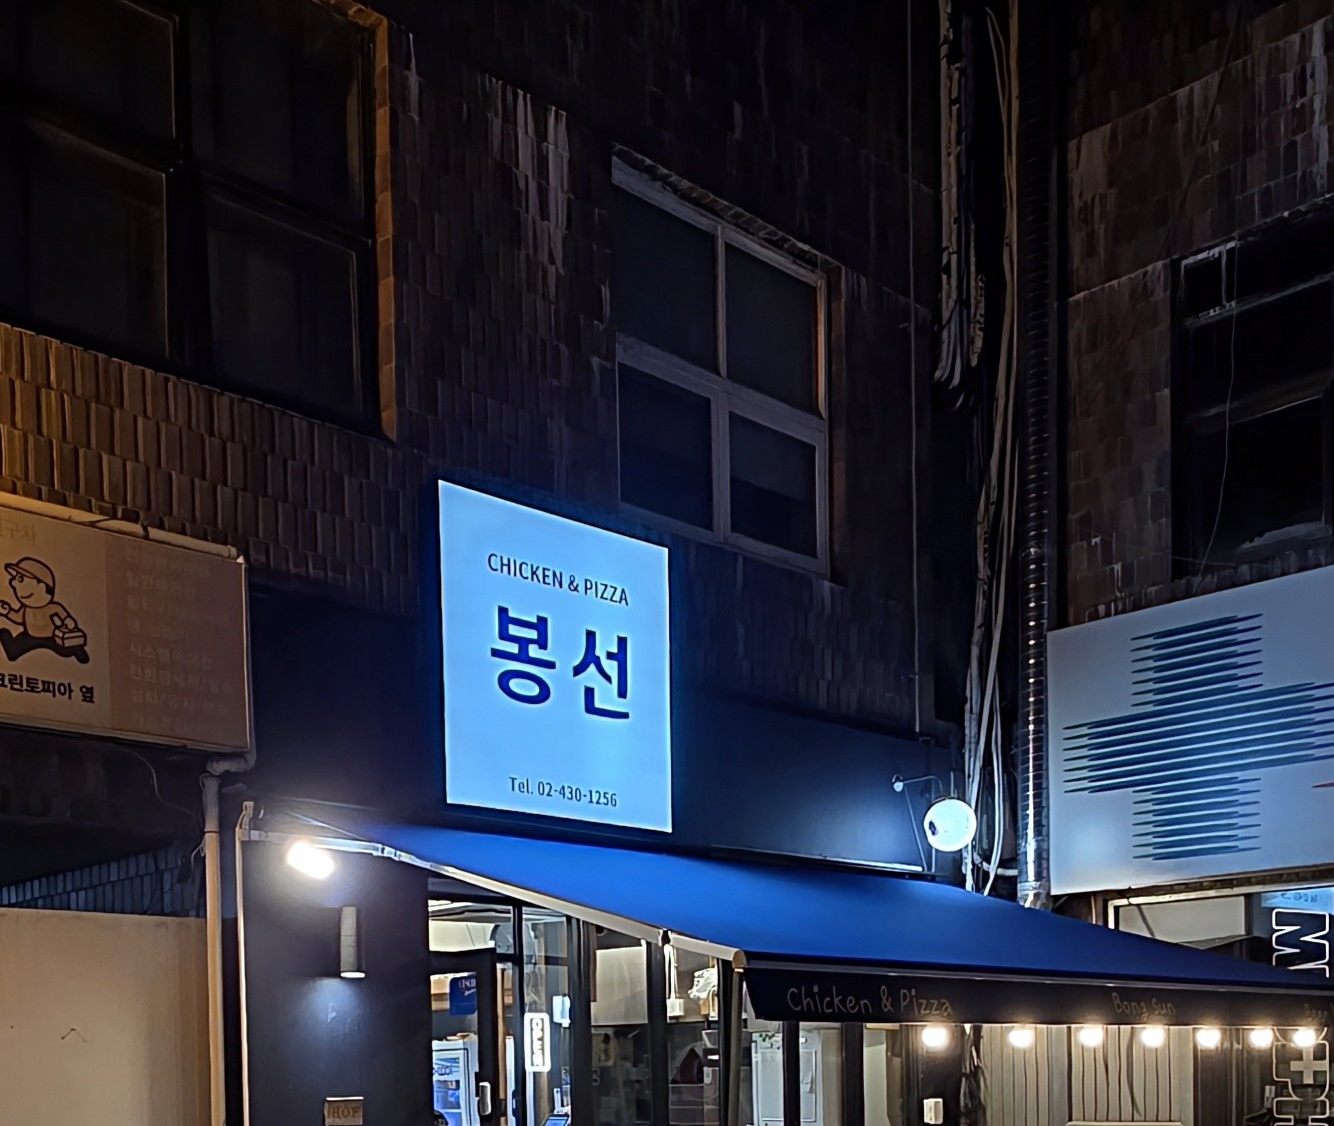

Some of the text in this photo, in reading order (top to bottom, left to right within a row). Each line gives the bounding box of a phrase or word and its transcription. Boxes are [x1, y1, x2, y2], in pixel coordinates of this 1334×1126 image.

[487, 552, 629, 607] CHICKEN & PIZZA
[79, 683, 95, 704] 옆
[509, 775, 618, 808] Tel. 02-430-1256
[787, 985, 873, 1014] Chicken
[880, 985, 894, 1013] &
[900, 988, 955, 1017] Pizza
